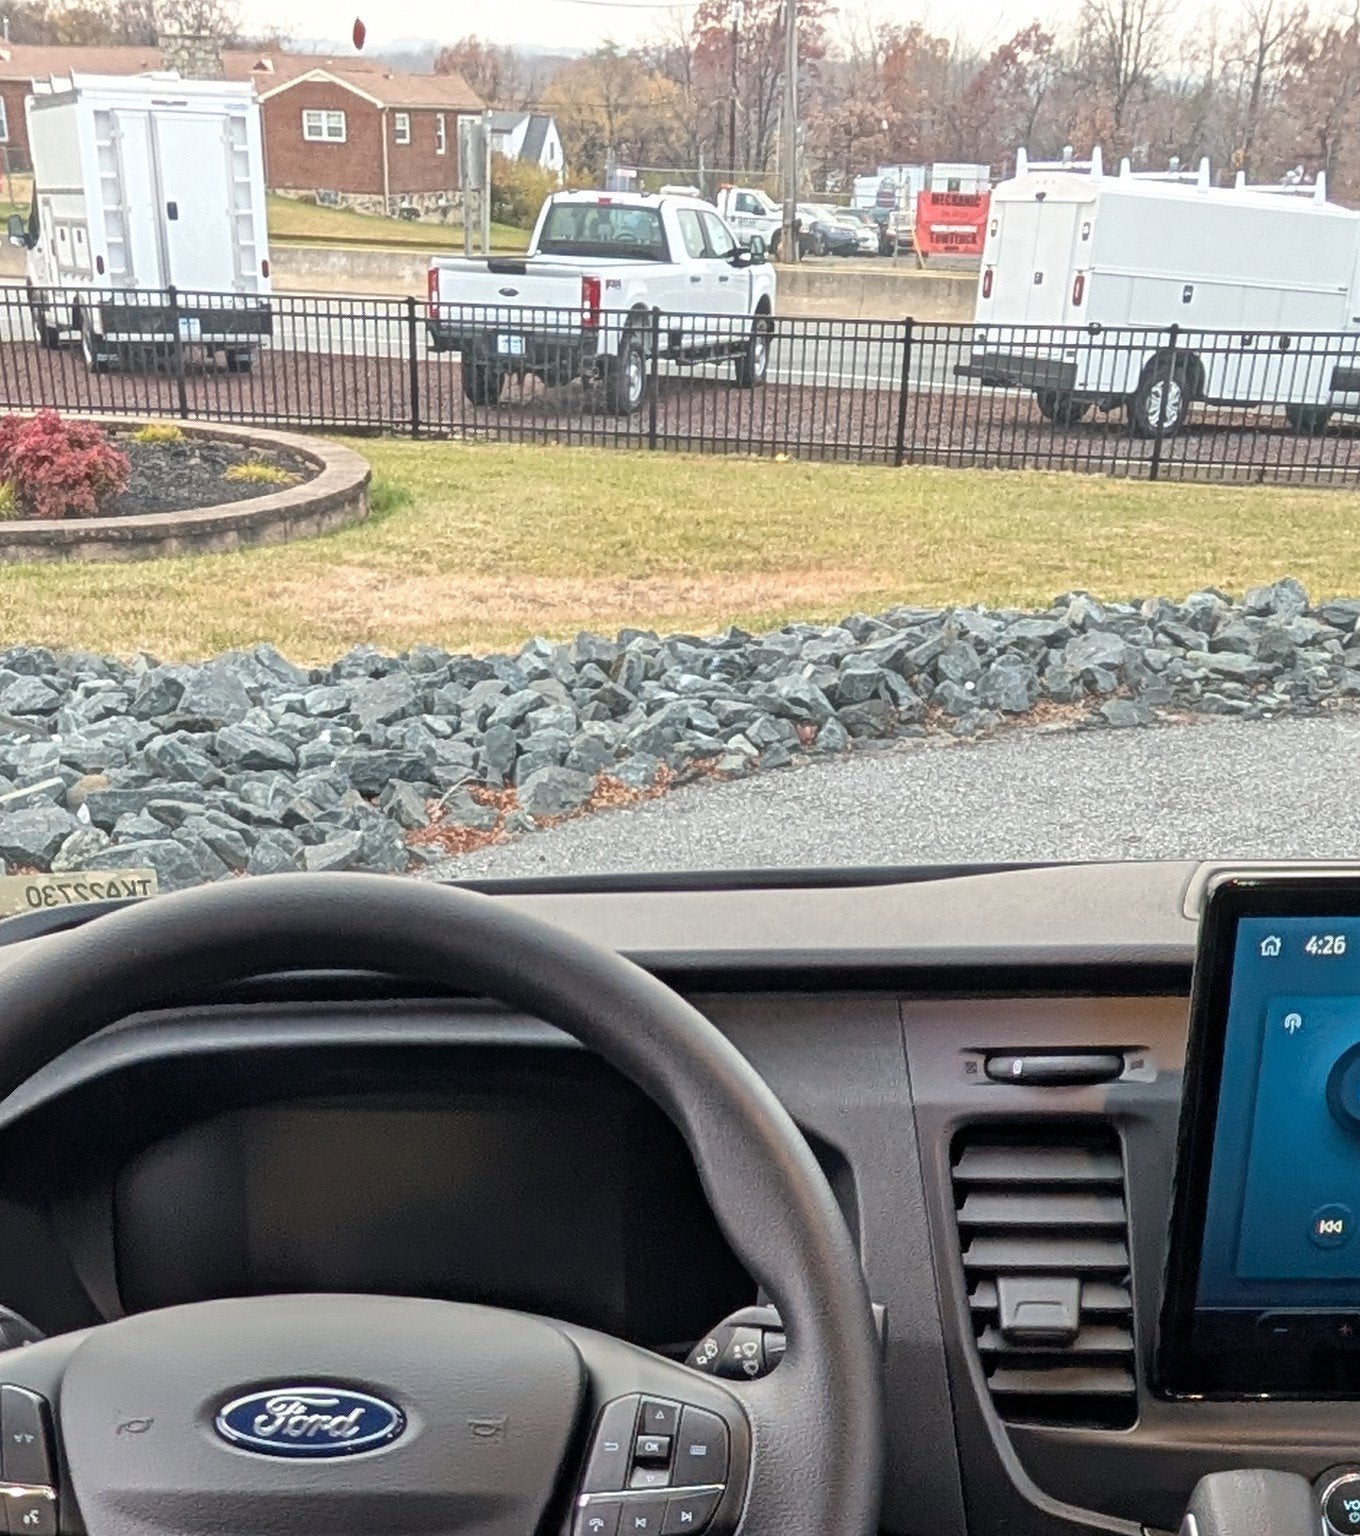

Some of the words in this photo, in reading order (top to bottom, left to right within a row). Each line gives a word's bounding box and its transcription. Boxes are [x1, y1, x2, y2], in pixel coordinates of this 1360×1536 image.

[1305, 935, 1346, 955] 4:26
[253, 1396, 365, 1438] Ford
[644, 1442, 660, 1453] OK
